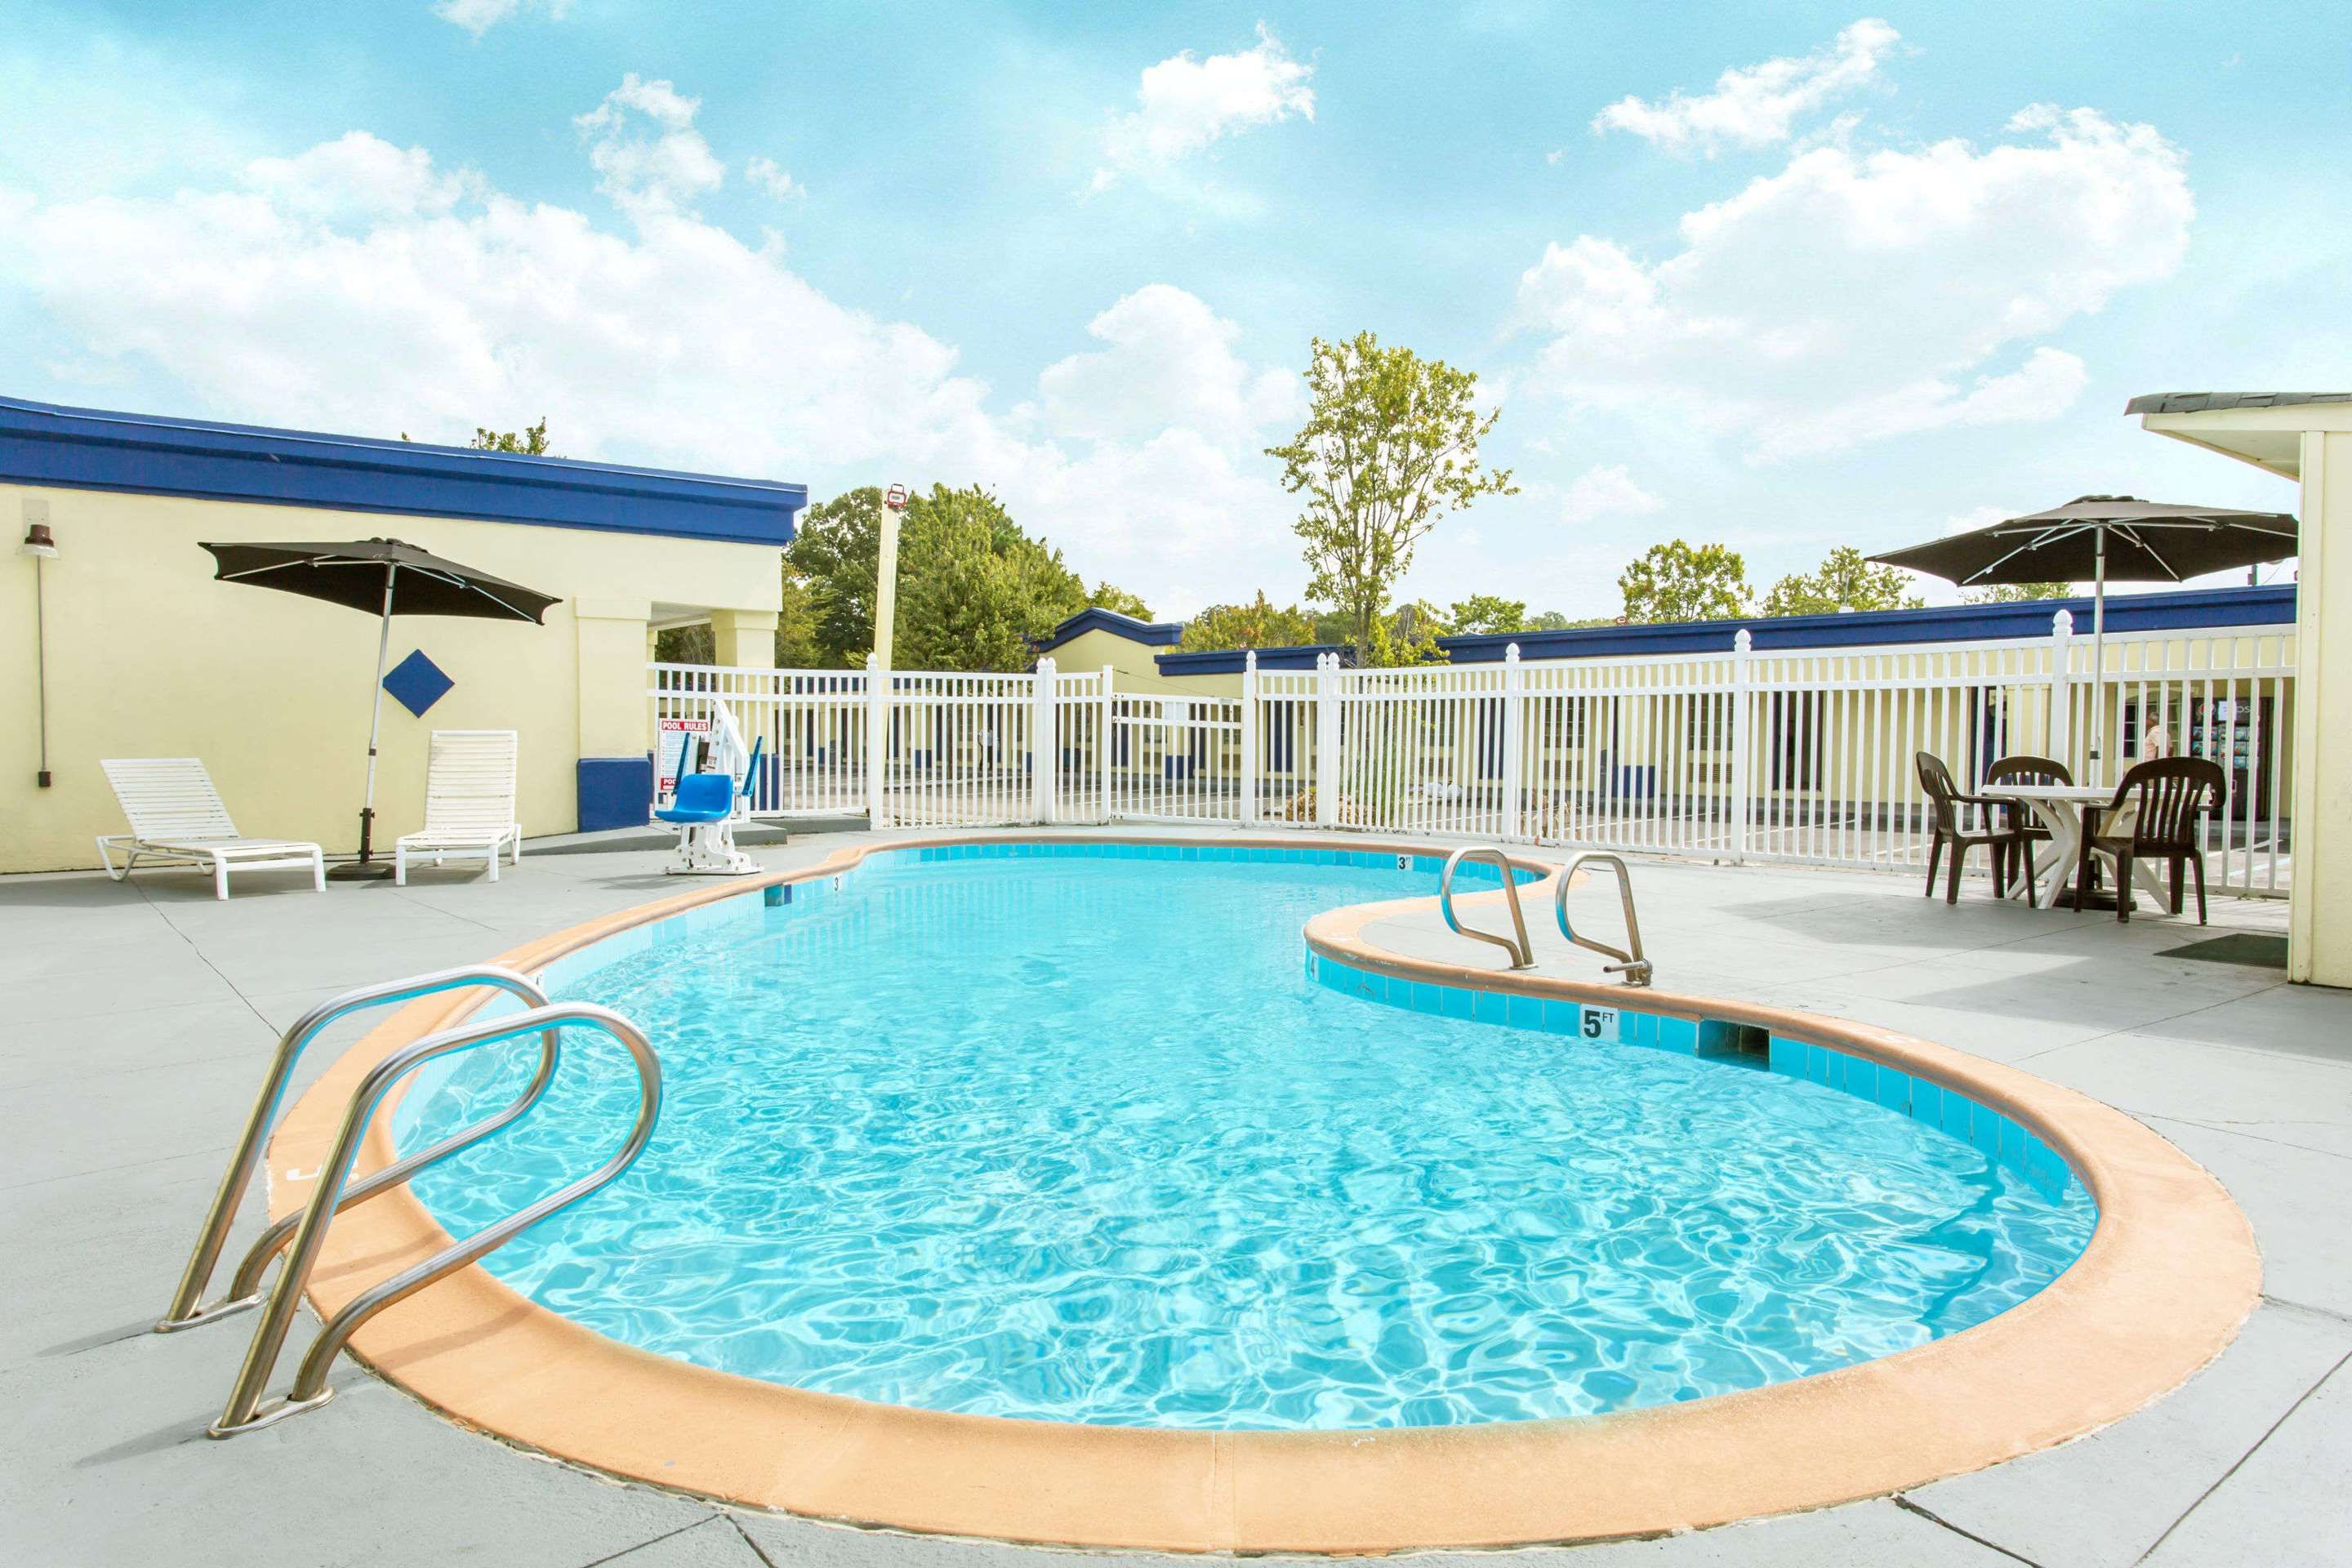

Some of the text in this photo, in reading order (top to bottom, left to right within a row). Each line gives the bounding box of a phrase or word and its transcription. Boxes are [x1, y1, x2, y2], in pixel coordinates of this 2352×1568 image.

[662, 721, 708, 731] POOL RULES
[1398, 857, 1405, 870] 3
[834, 877, 839, 892] 3
[1584, 1009, 1615, 1038] 5 FT
